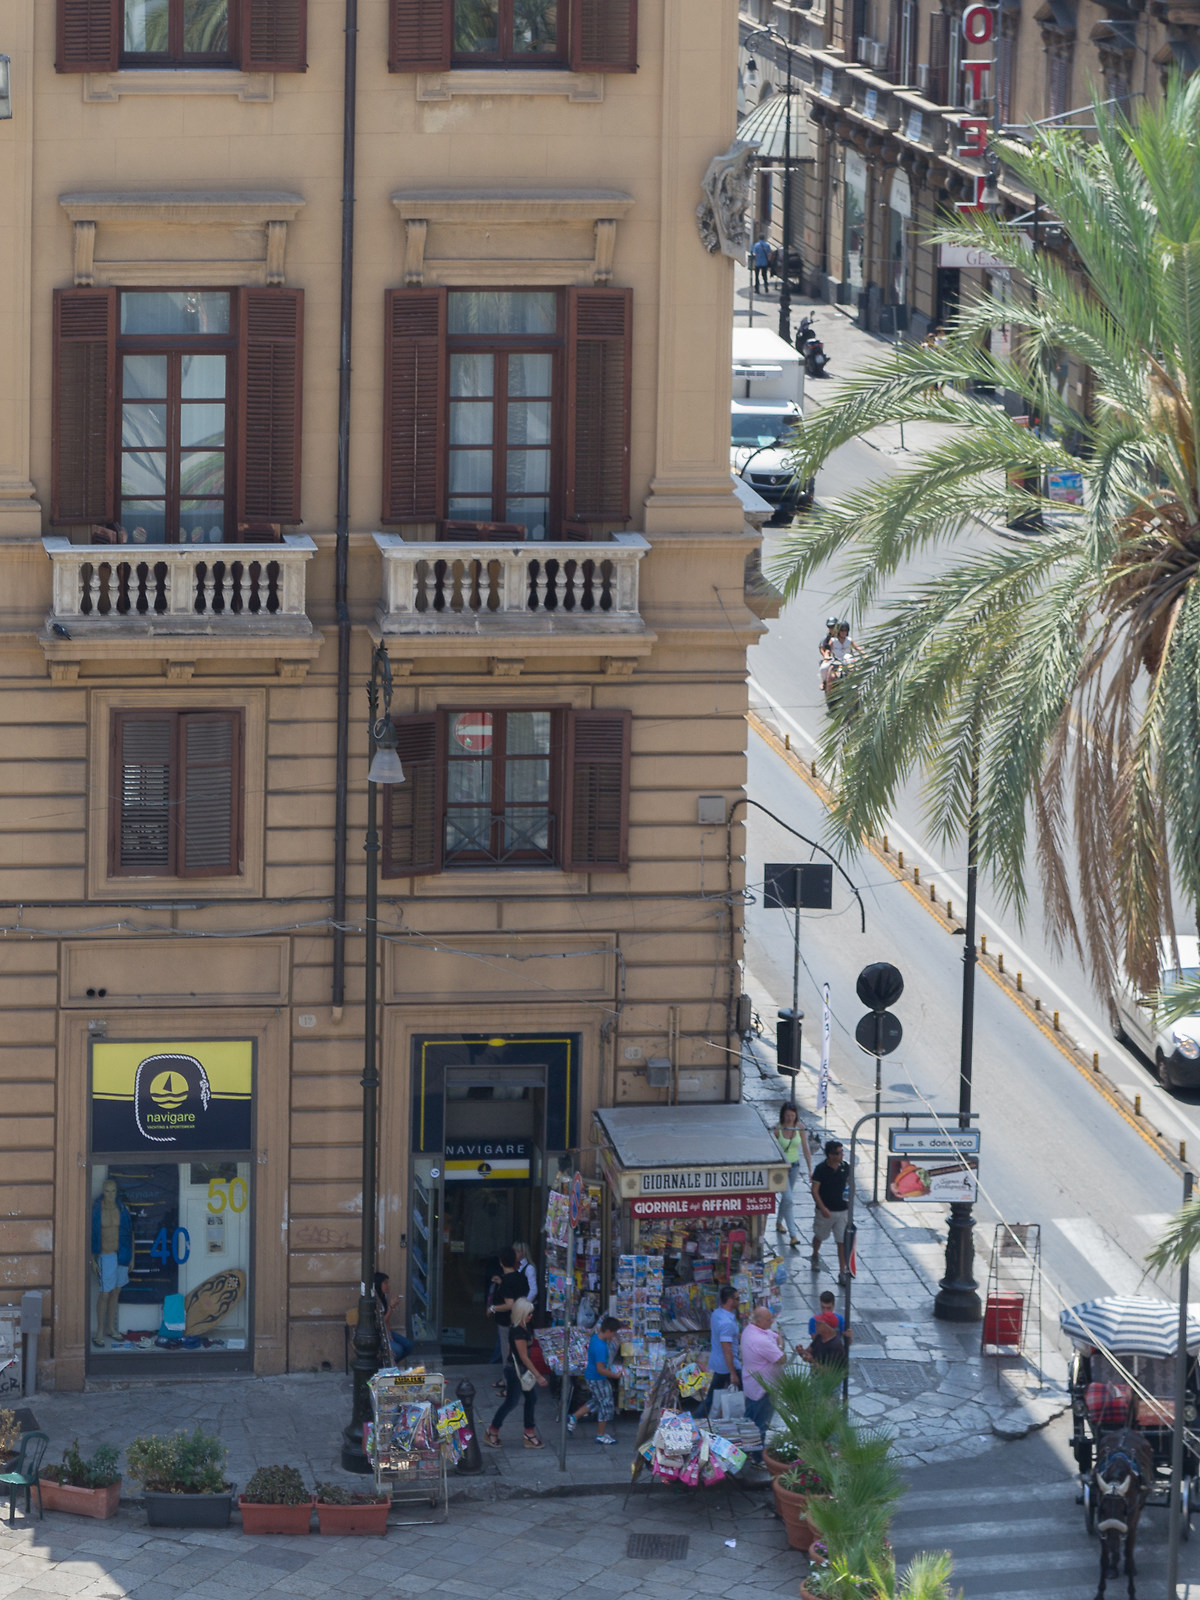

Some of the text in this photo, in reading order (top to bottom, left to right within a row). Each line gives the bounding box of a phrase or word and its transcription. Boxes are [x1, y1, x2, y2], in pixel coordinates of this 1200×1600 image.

[146, 1111, 196, 1125] navigare
[445, 1144, 525, 1155] NAVIGARE
[643, 1171, 764, 1190] GIORNALE DI SICILIA
[207, 1177, 249, 1214] 50
[634, 1201, 688, 1214] GIORNALE
[702, 1199, 742, 1211] AFFARI
[150, 1226, 191, 1266] 40
